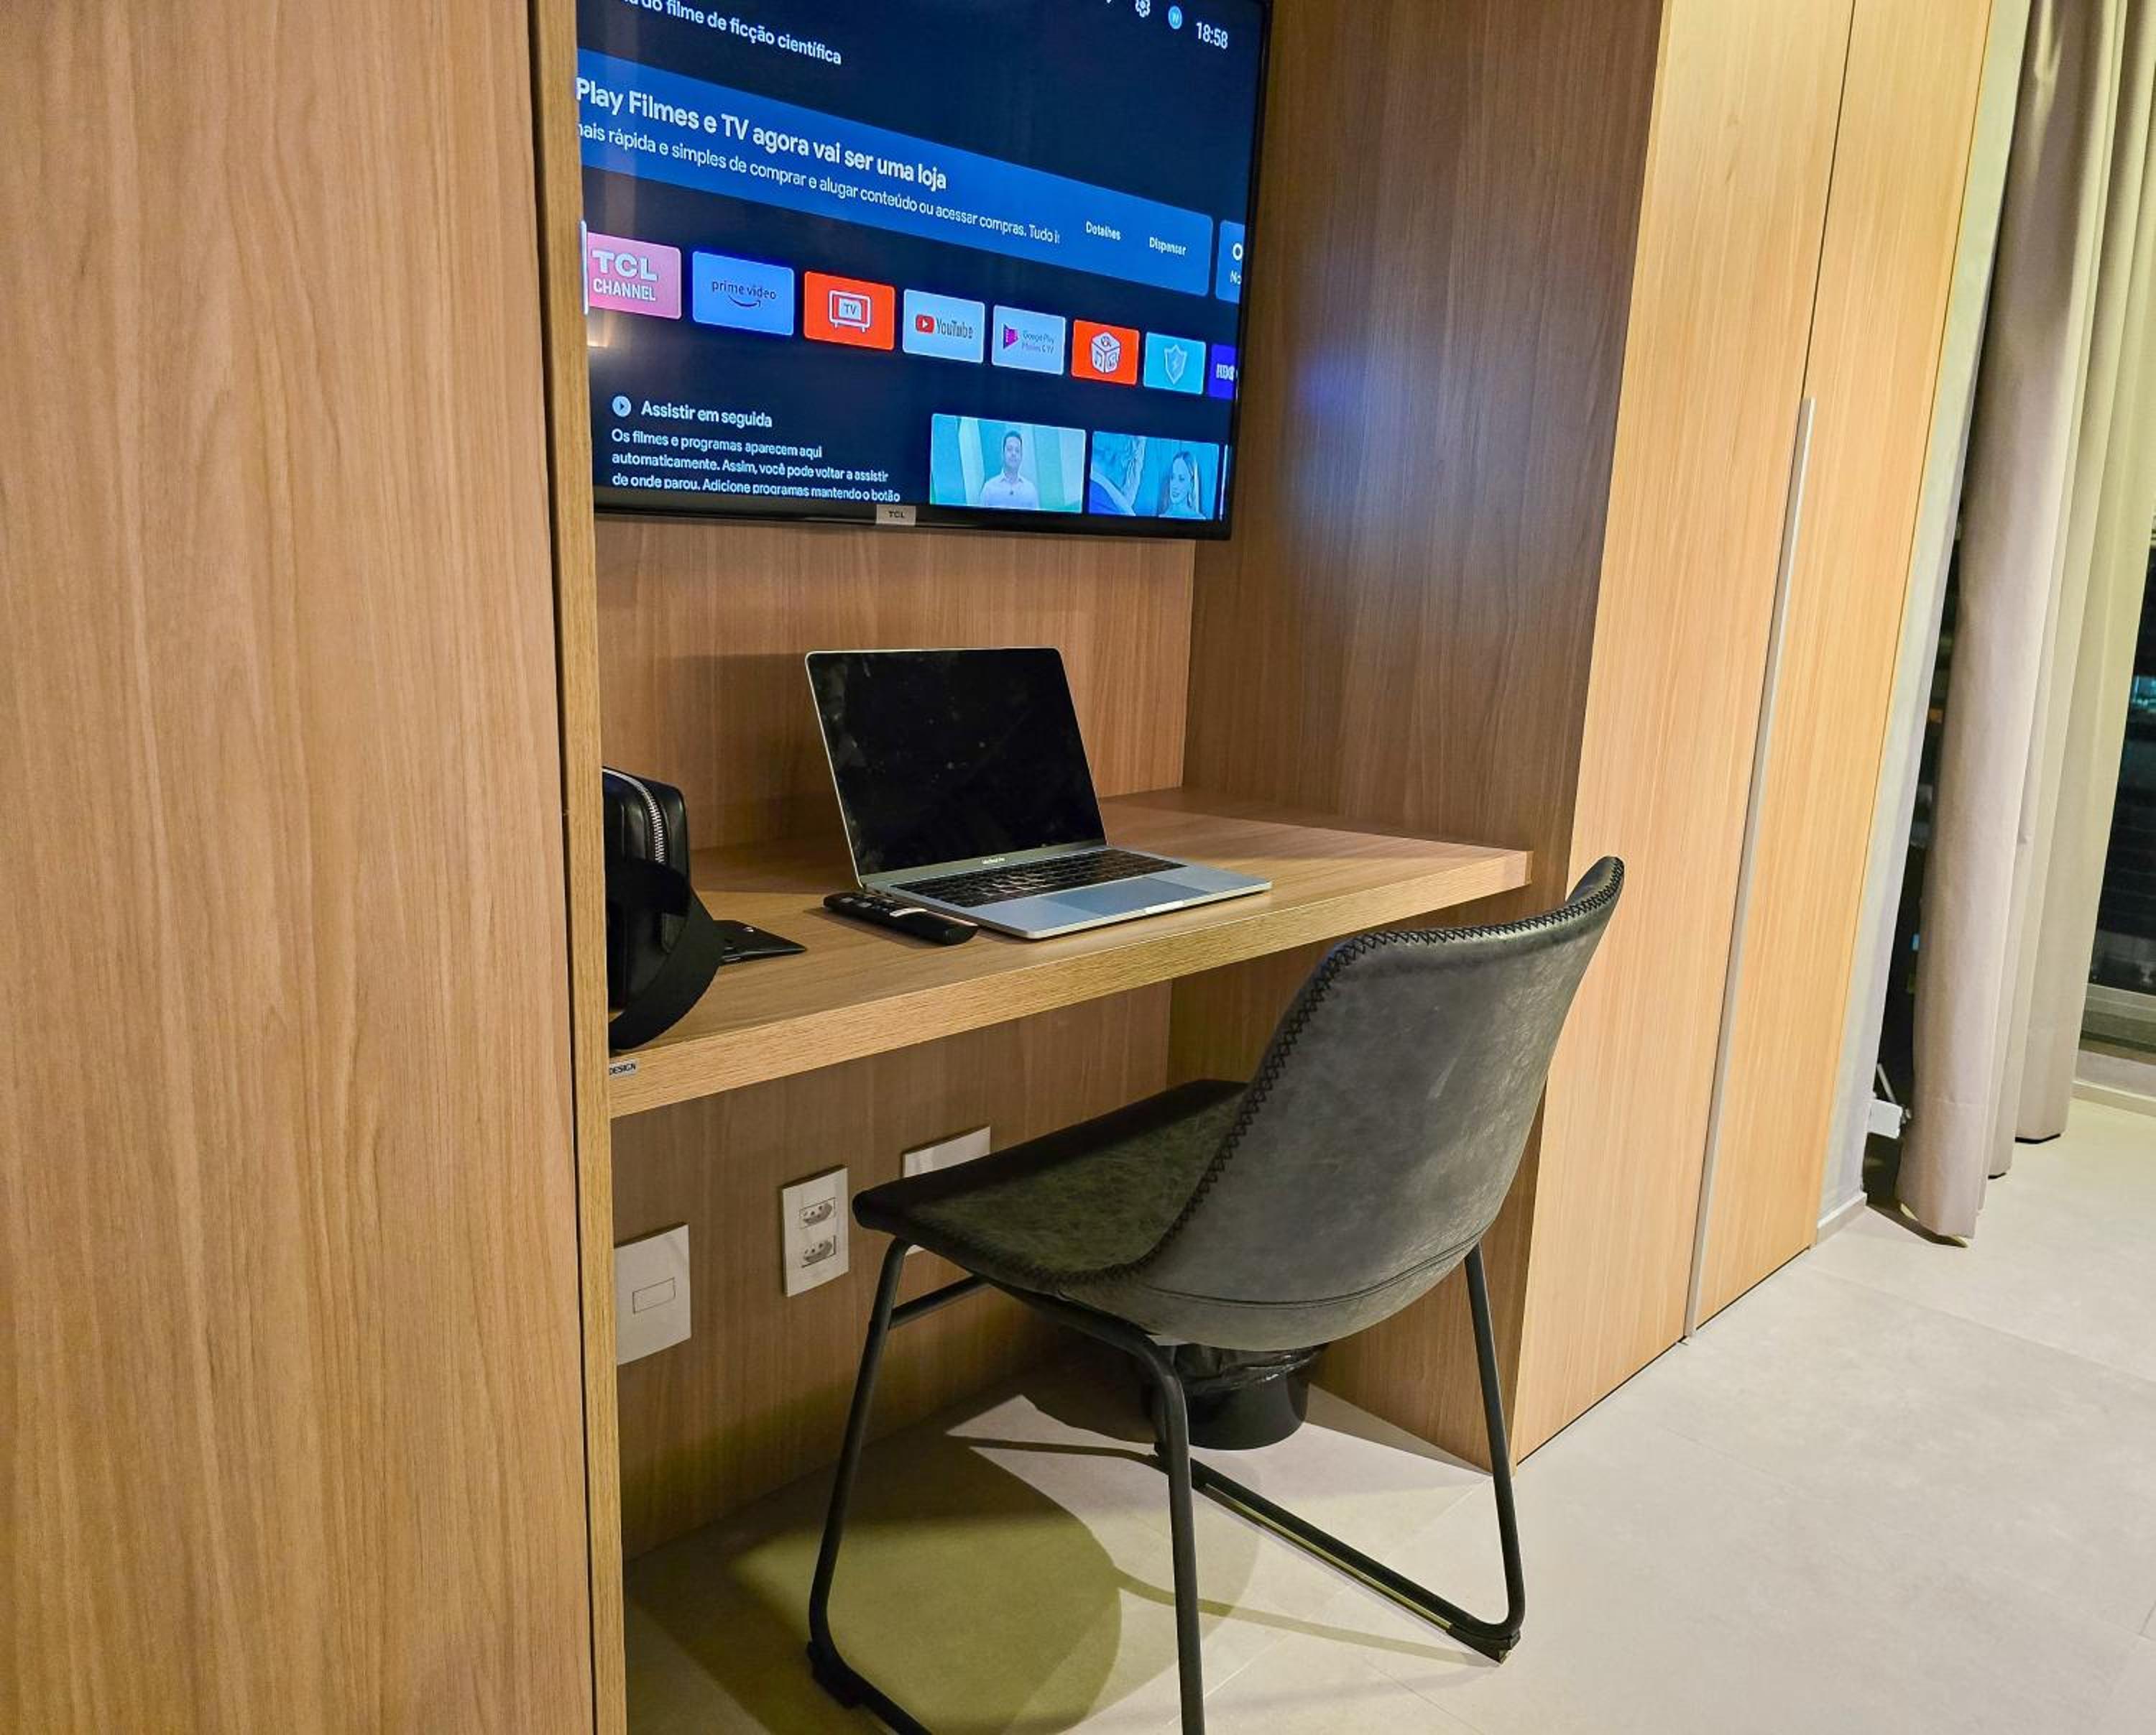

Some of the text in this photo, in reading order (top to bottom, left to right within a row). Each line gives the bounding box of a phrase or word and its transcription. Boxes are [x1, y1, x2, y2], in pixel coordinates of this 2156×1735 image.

[665, 1, 704, 24] filme
[706, 11, 727, 31] de
[729, 17, 775, 45] ficção
[778, 34, 842, 65] científica
[1196, 22, 1228, 50] 18:58
[575, 77, 947, 192] Play Filmes e TV agora vai ser uma loja
[609, 128, 656, 153] rápida
[659, 142, 669, 156] e
[672, 142, 727, 170] simples
[729, 155, 747, 173] de
[750, 162, 807, 186] comprar
[808, 175, 817, 189] e
[819, 177, 859, 200] alugar
[860, 188, 918, 213] conteúdo
[918, 201, 934, 216] ou
[936, 206, 978, 226] acessar
[980, 215, 1027, 236] compras.
[1028, 224, 1054, 243] Tudo
[591, 249, 658, 282] TCL
[592, 277, 656, 302] CHANNEL
[711, 280, 777, 300] prime video
[843, 302, 857, 316] TV
[936, 316, 973, 339] YouTube
[641, 400, 773, 429] Assistir em seguida
[611, 428, 823, 461] Os filmes e programas aparecem aqui
[612, 452, 889, 483] automaticamente. Assim, você pode voltar a assistir
[612, 473, 901, 502] de onde parou. Adicione programas mantendo o botão
[888, 510, 906, 518] TCL
